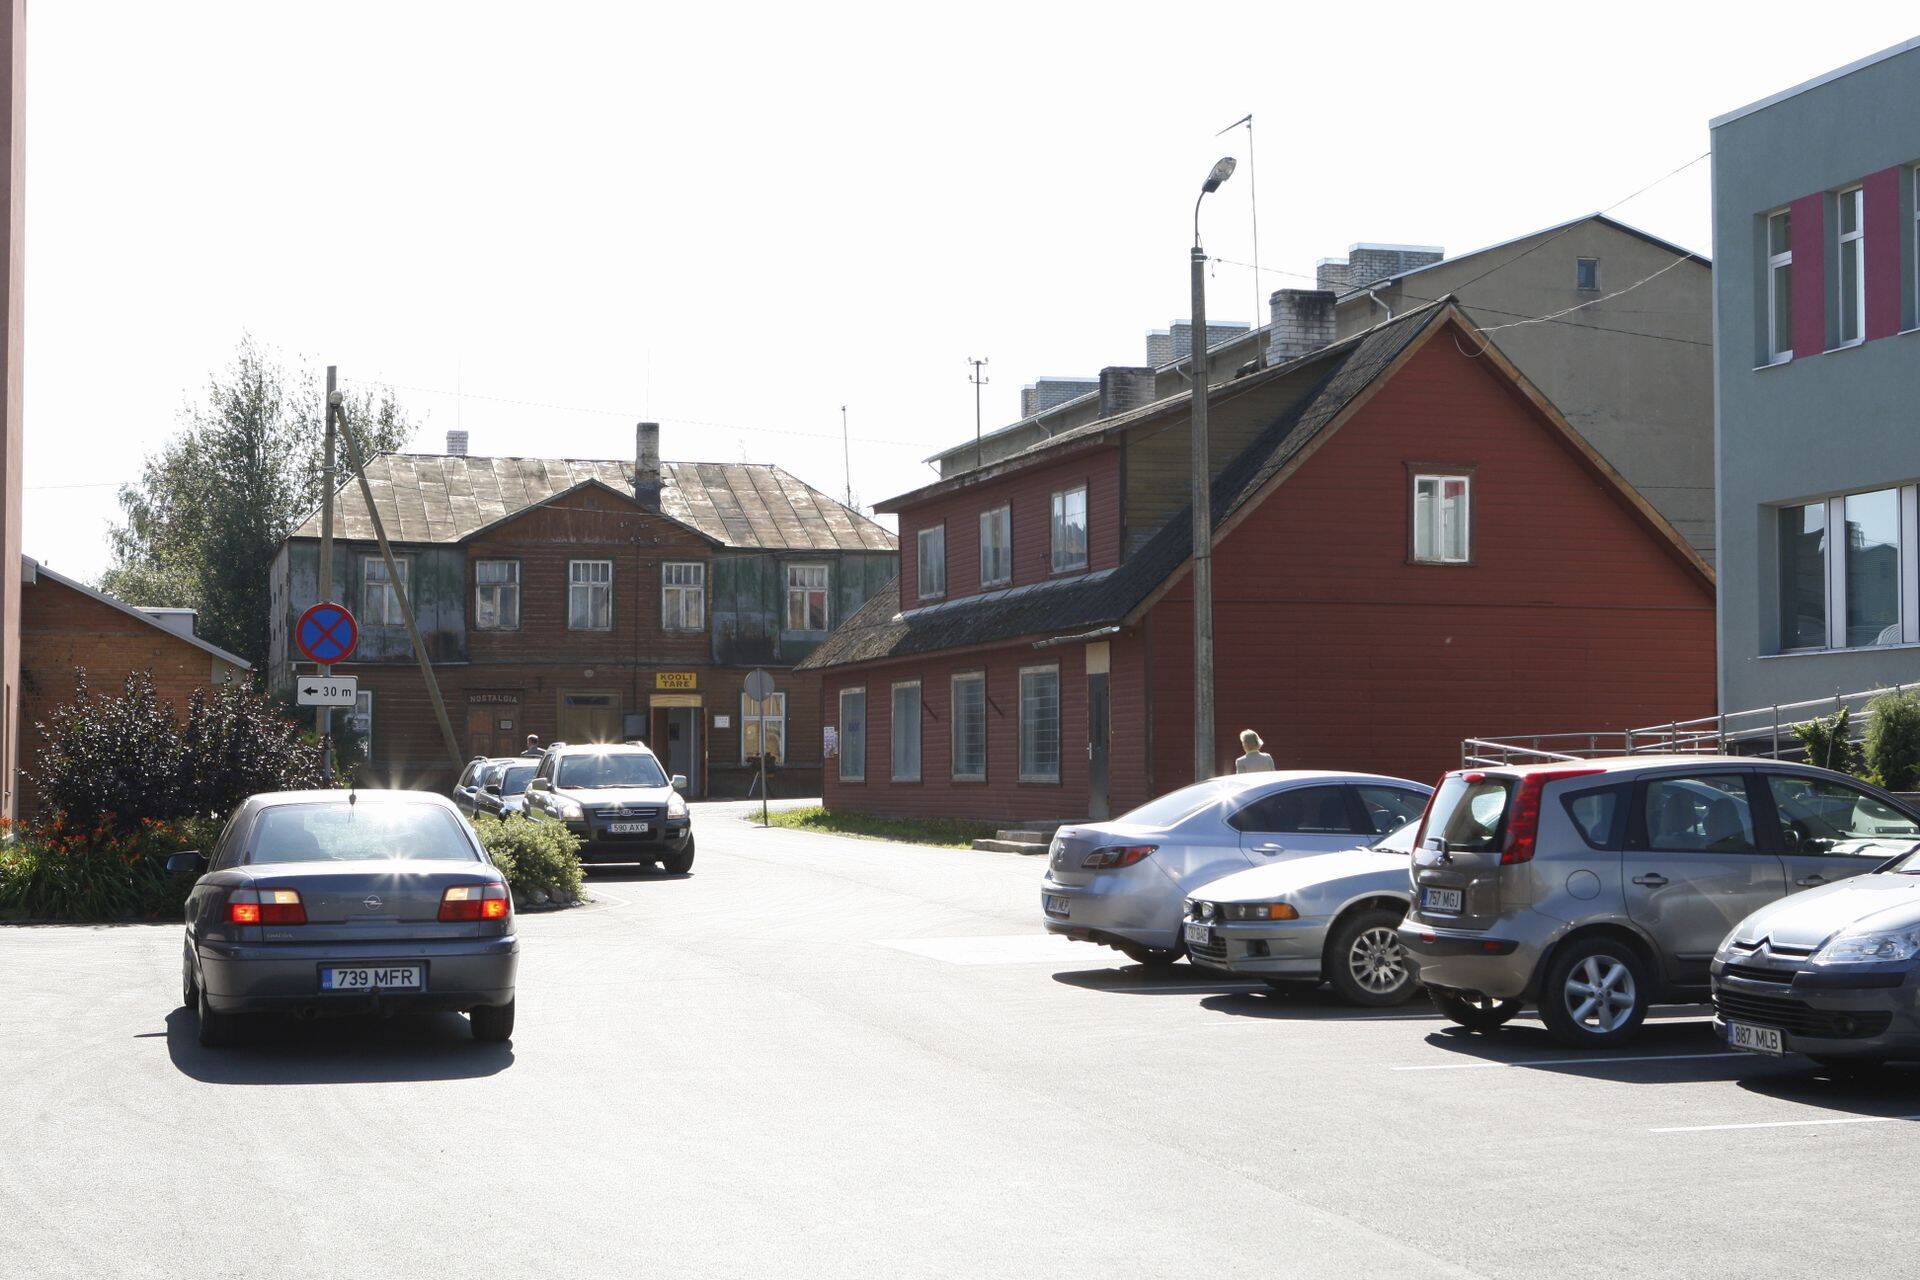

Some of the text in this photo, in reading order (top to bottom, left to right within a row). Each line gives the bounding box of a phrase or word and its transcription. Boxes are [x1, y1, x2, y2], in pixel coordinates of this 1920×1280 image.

[323, 686, 352, 697] 30 m
[629, 823, 645, 831] AXC
[1428, 890, 1460, 908] 757 MGJ
[338, 969, 414, 987] 739 MFR
[1735, 1026, 1778, 1050] 887 MLB
